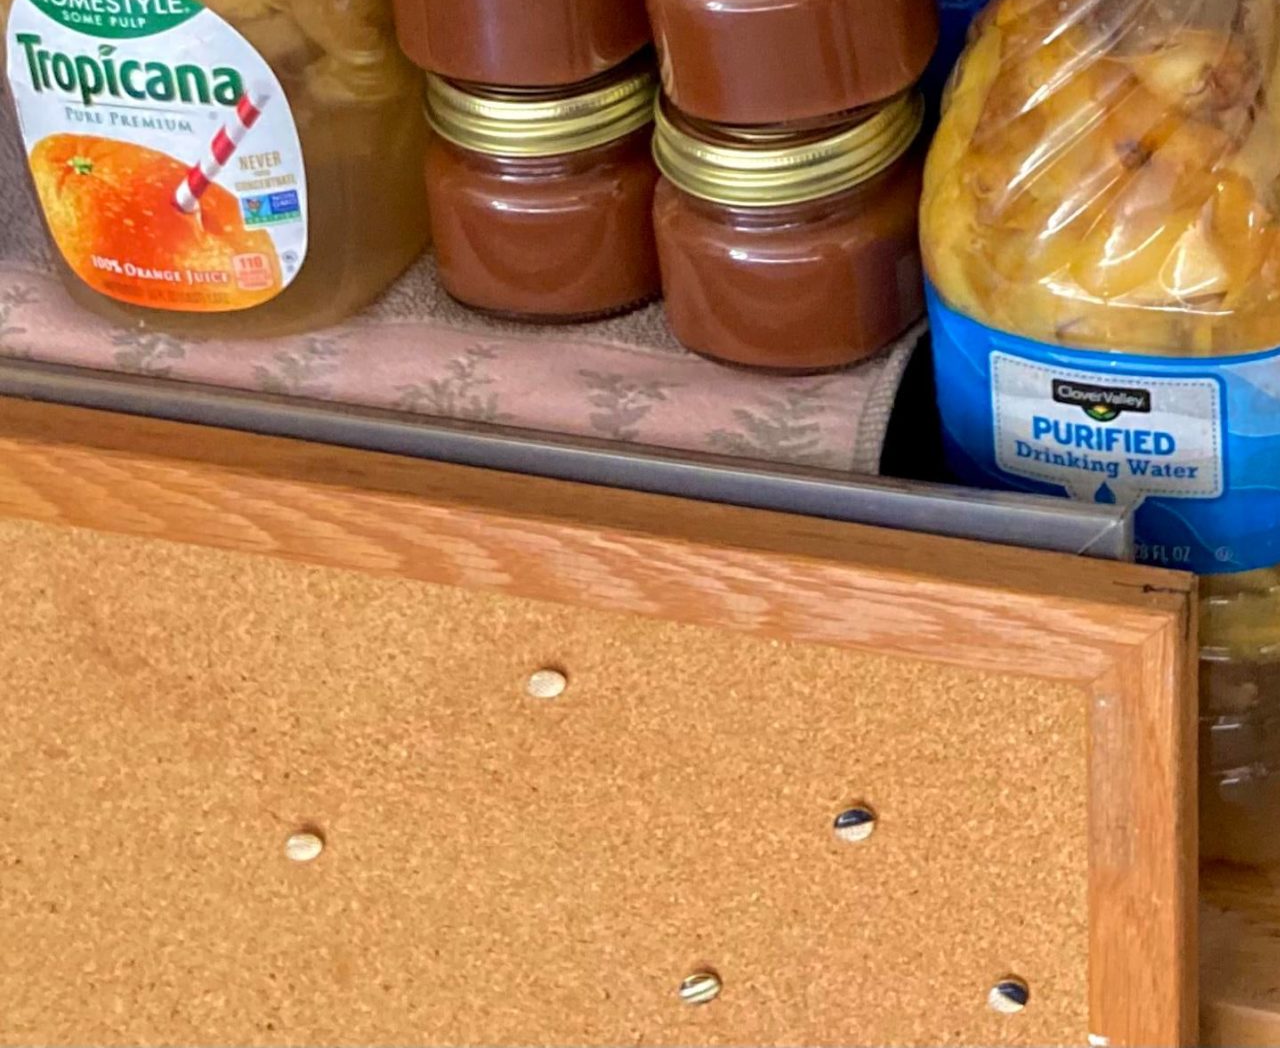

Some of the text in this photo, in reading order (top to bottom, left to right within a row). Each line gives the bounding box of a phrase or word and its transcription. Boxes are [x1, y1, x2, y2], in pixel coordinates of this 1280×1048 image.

[62, 9, 147, 29] SOME PULP
[15, 32, 245, 107] Tropicana
[65, 105, 193, 133] PURE PREMIUM
[238, 150, 281, 170] NEVER
[91, 254, 123, 274] 100%
[124, 261, 183, 283] ORANGE
[186, 268, 230, 287] JUICE
[1032, 415, 1176, 456] PURIFIED
[1015, 440, 1200, 480] Drinking Water
